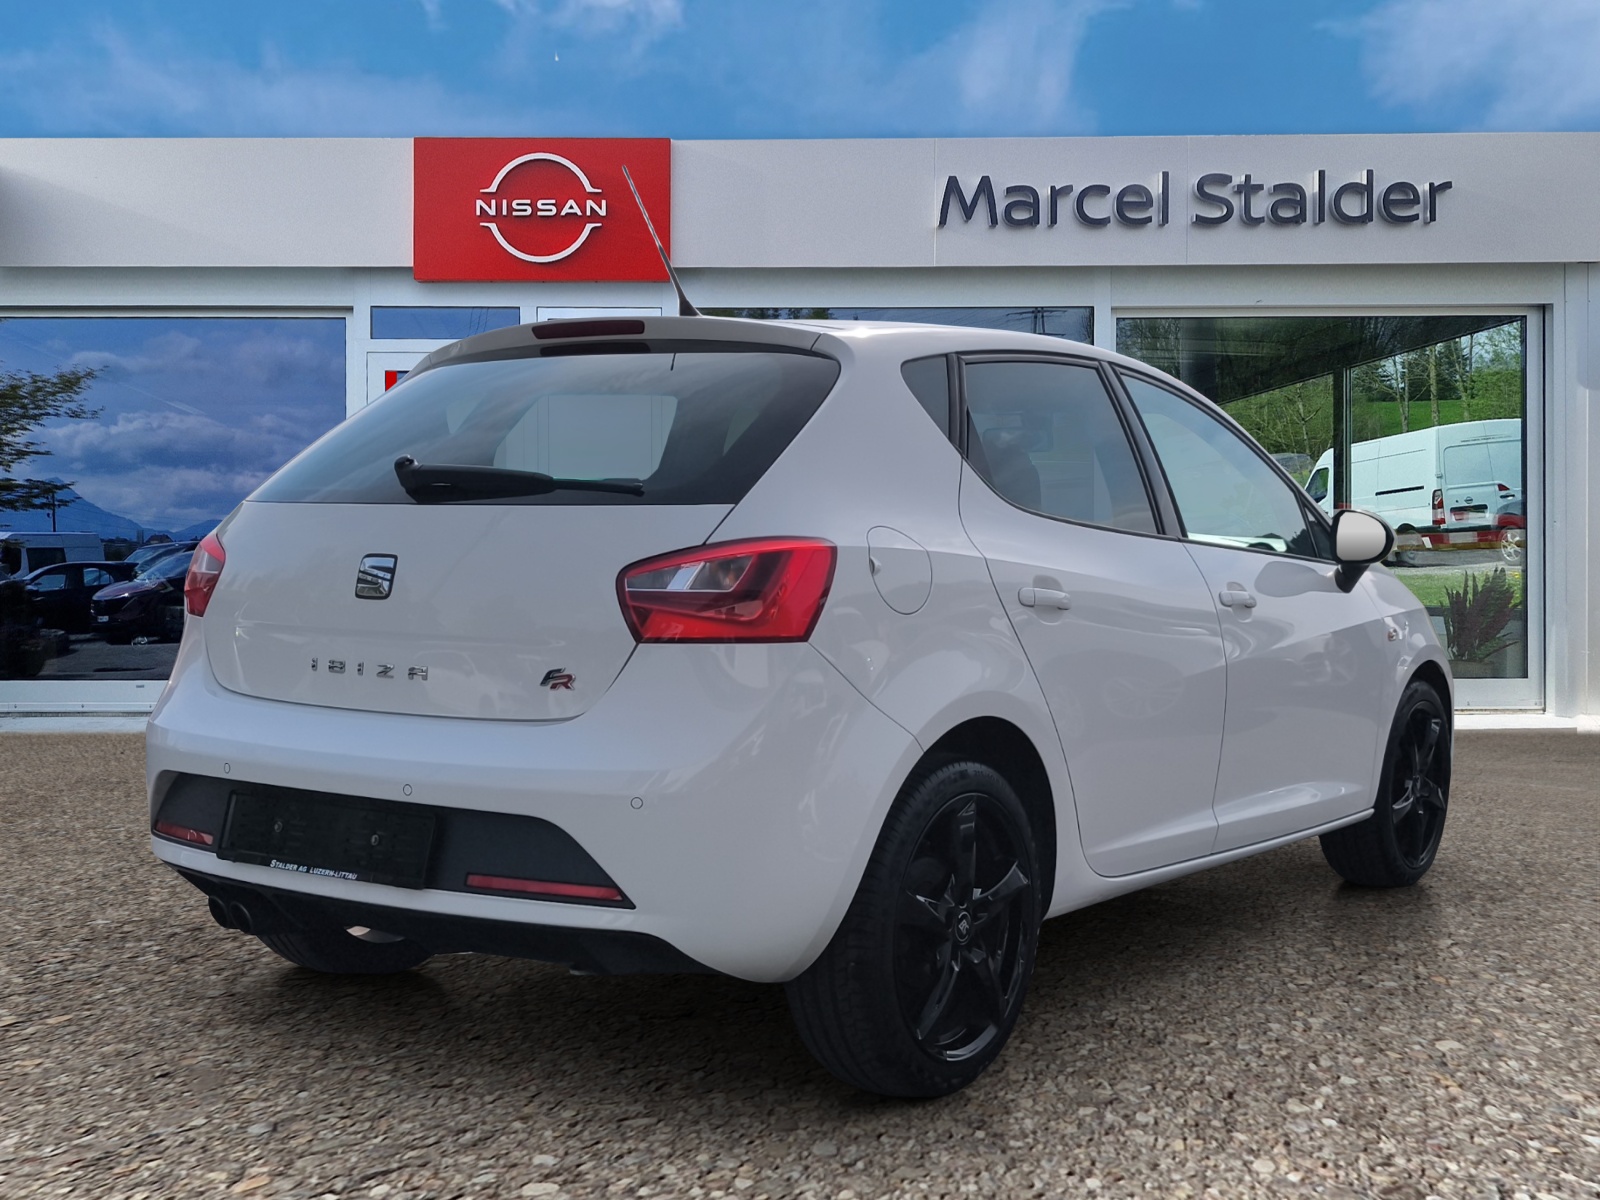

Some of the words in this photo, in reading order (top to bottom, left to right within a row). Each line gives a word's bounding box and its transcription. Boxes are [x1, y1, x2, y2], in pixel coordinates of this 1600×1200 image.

[475, 199, 607, 217] NISSAN
[938, 171, 1169, 229] Marcel
[1191, 168, 1453, 226] Stalder
[311, 658, 429, 681] IBIZA
[540, 667, 576, 690] FR
[270, 859, 298, 871] STALDER
[298, 865, 308, 873] AG
[309, 866, 358, 880] LUZERN-LITTAU
